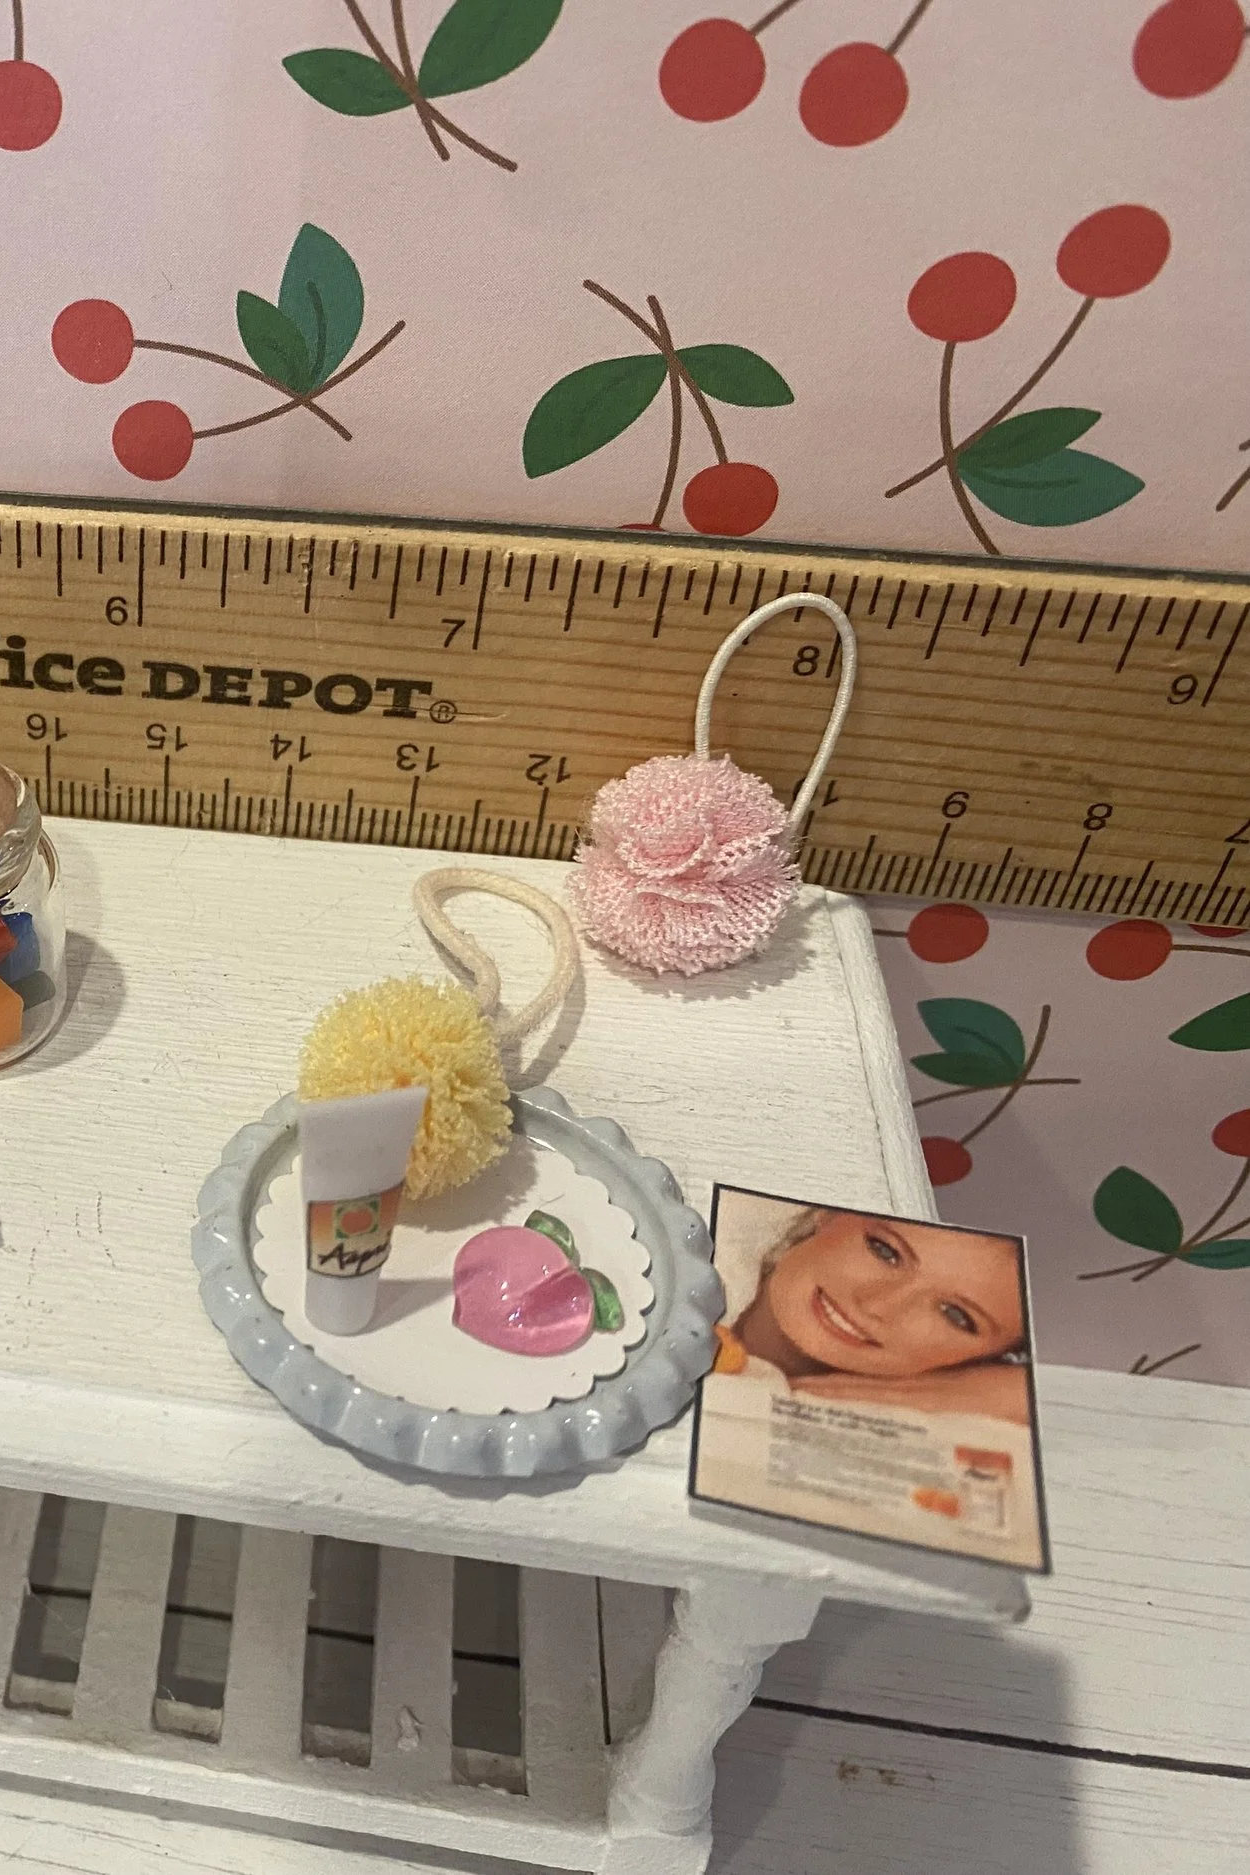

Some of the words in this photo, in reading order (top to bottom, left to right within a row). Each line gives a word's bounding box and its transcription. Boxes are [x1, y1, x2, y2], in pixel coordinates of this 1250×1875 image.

[105, 595, 128, 626] 6
[439, 618, 466, 649] 7
[792, 645, 820, 678] 8
[1166, 673, 1198, 706] 9
[25, 712, 68, 742] 16
[145, 722, 189, 752] 15
[269, 733, 312, 763] 14
[395, 742, 440, 773] 13
[524, 753, 572, 784] 12
[1083, 802, 1113, 831] 8
